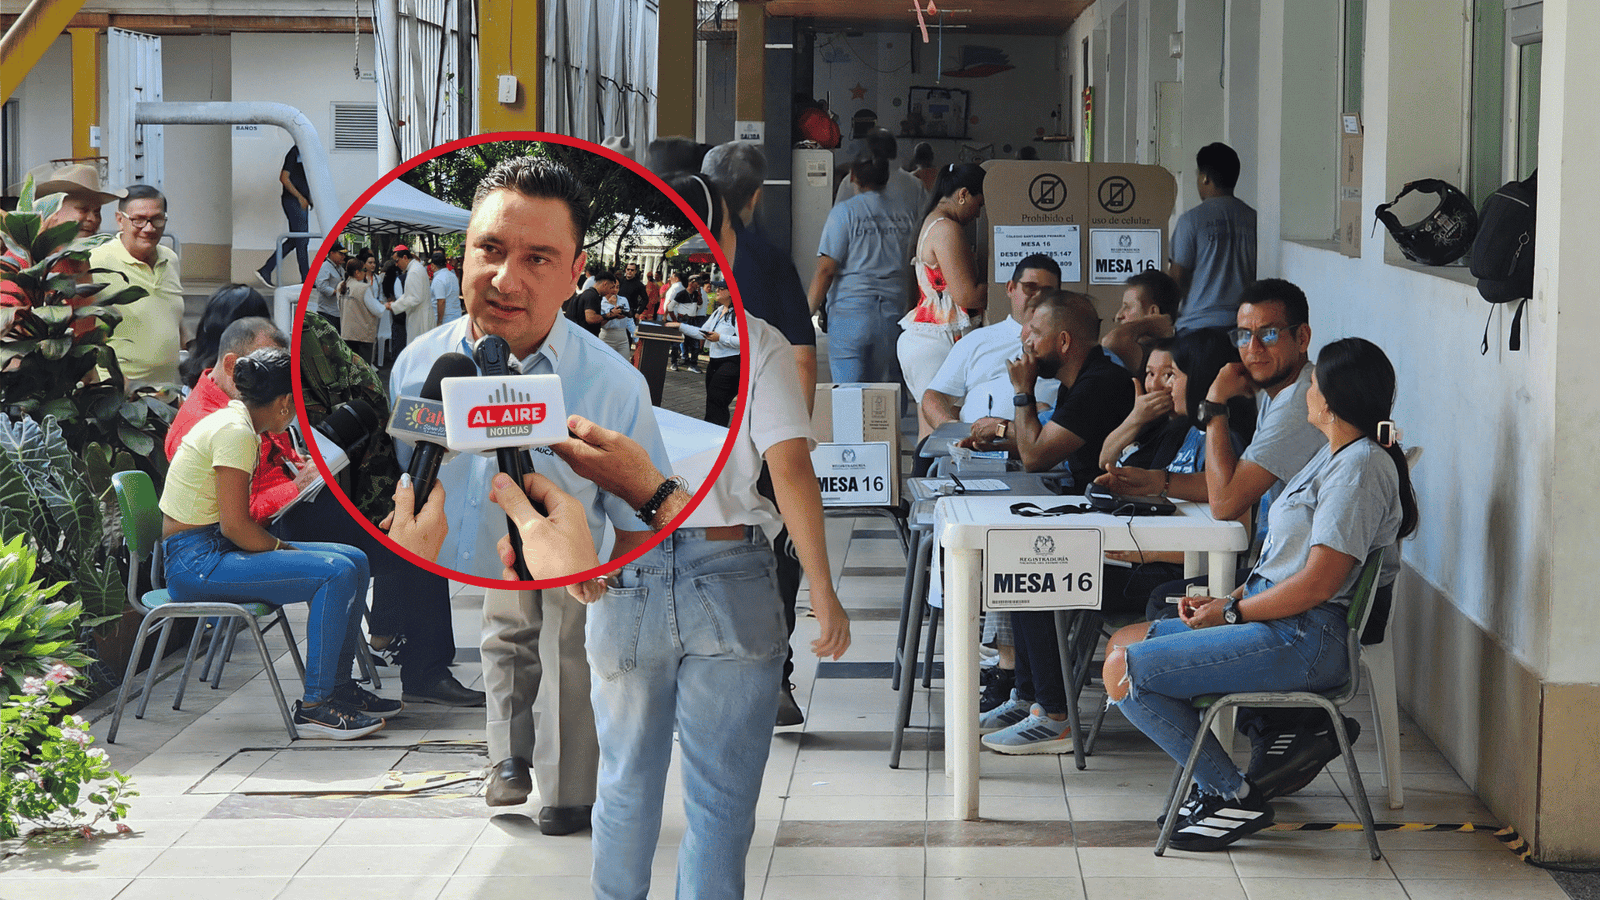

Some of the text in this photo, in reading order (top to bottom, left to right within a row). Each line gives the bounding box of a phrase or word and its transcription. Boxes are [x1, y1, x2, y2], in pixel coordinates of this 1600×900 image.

[1021, 213, 1074, 223] Prohibido el
[1108, 216, 1120, 225] de
[1121, 216, 1151, 225] celular
[1095, 258, 1155, 273] MESA 16
[472, 407, 542, 424] AL AIRE
[489, 425, 529, 436] NOTICIAS
[532, 446, 554, 457] AUCA
[819, 476, 884, 493] MESA 16
[993, 572, 1093, 593] MESA 16
